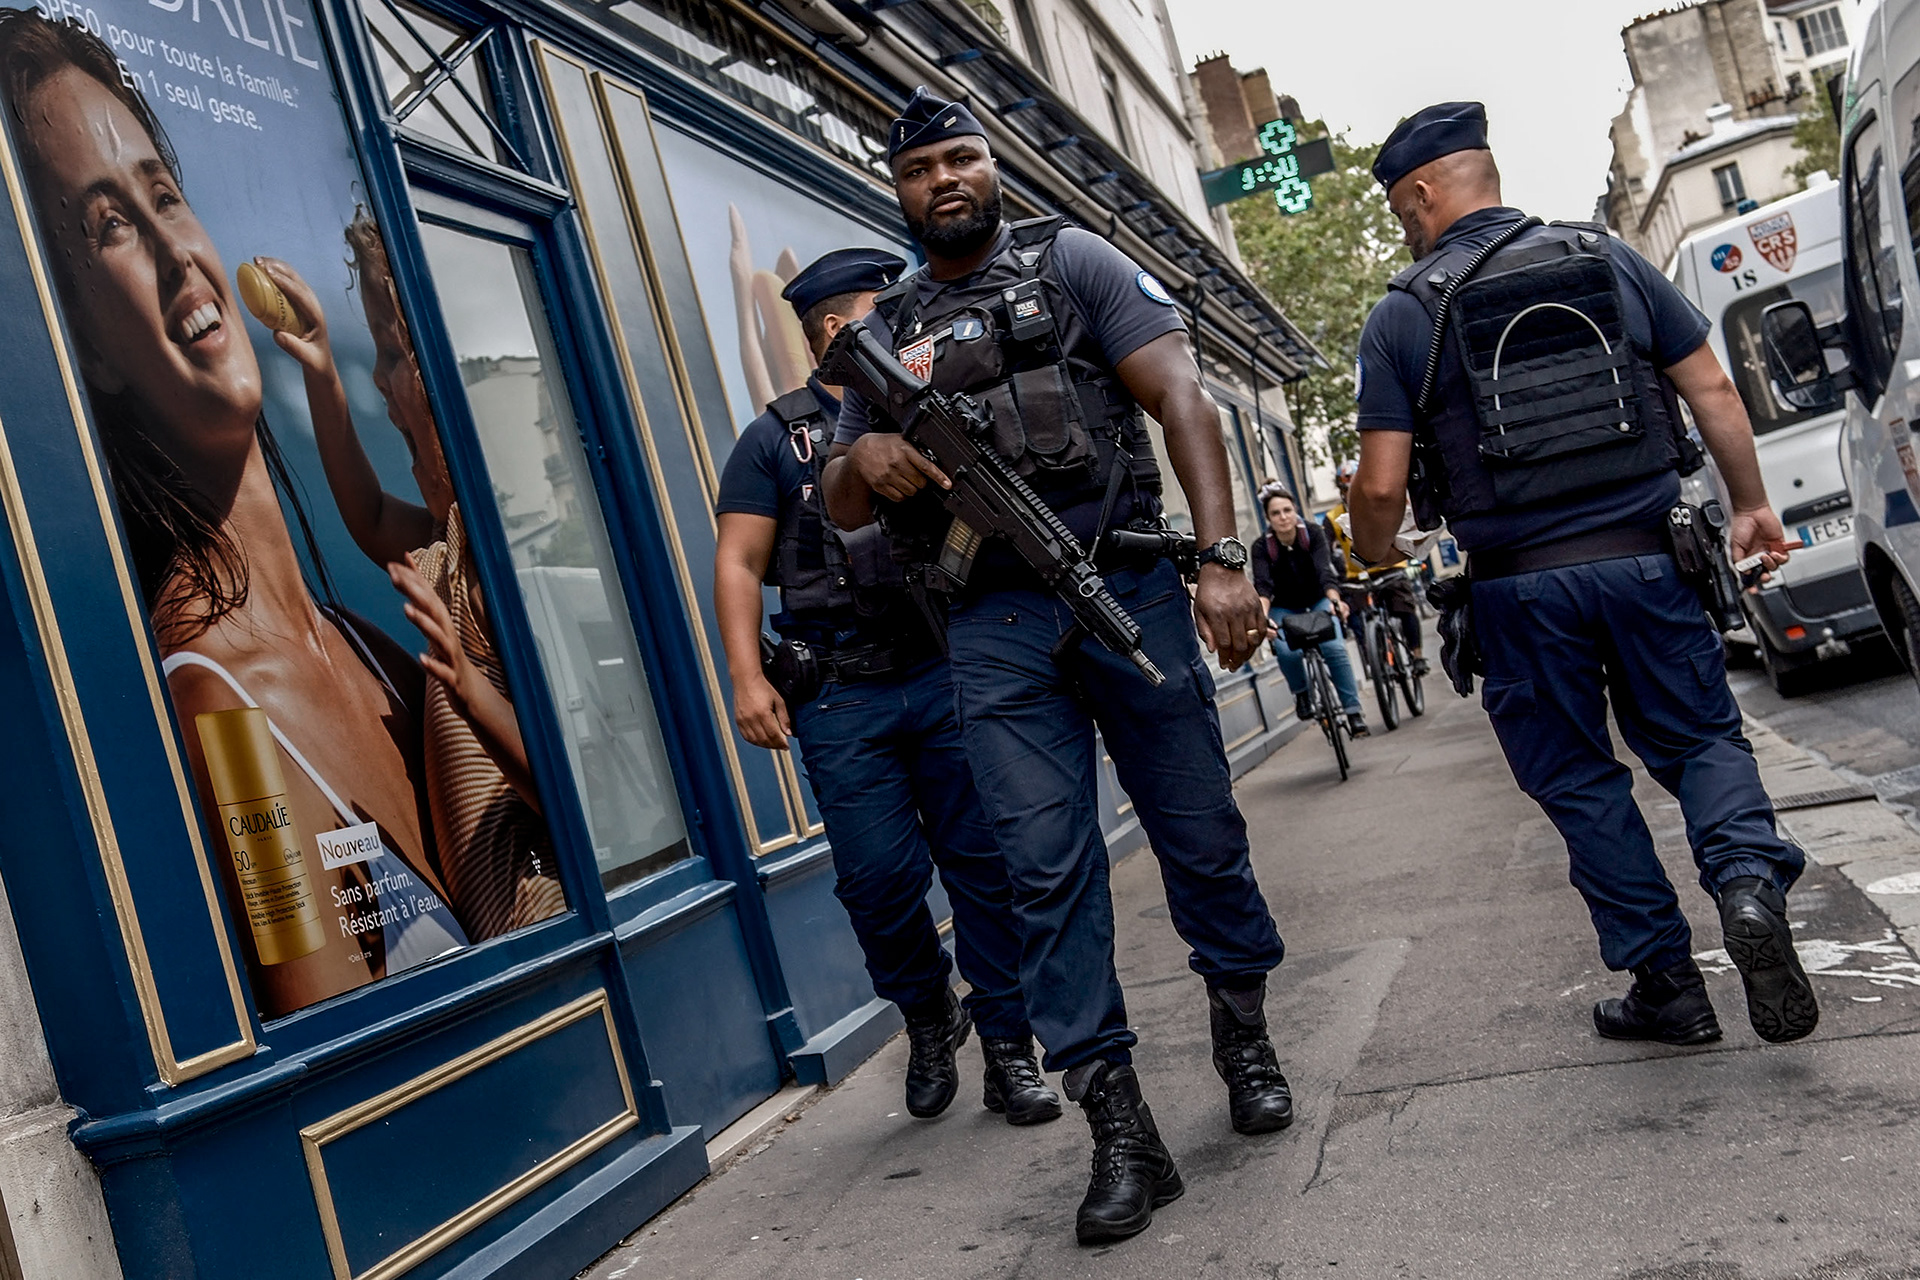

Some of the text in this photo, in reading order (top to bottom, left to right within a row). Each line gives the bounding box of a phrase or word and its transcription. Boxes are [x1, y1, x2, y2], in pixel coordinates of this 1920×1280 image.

[35, 0, 102, 38] SPF50
[107, 22, 155, 57] pour
[160, 39, 214, 79] toute
[216, 55, 236, 87] la
[148, 0, 319, 70] LIE
[116, 58, 263, 131] En 1 seul geste.
[1757, 229, 1795, 254] CRS
[906, 353, 930, 373] CRS
[1813, 515, 1854, 541] FC-5
[234, 850, 251, 872] 50
[320, 835, 380, 862] Nouveau
[330, 871, 414, 908] Sans parfum.
[338, 904, 400, 938] Résistant
[400, 898, 411, 919] à
